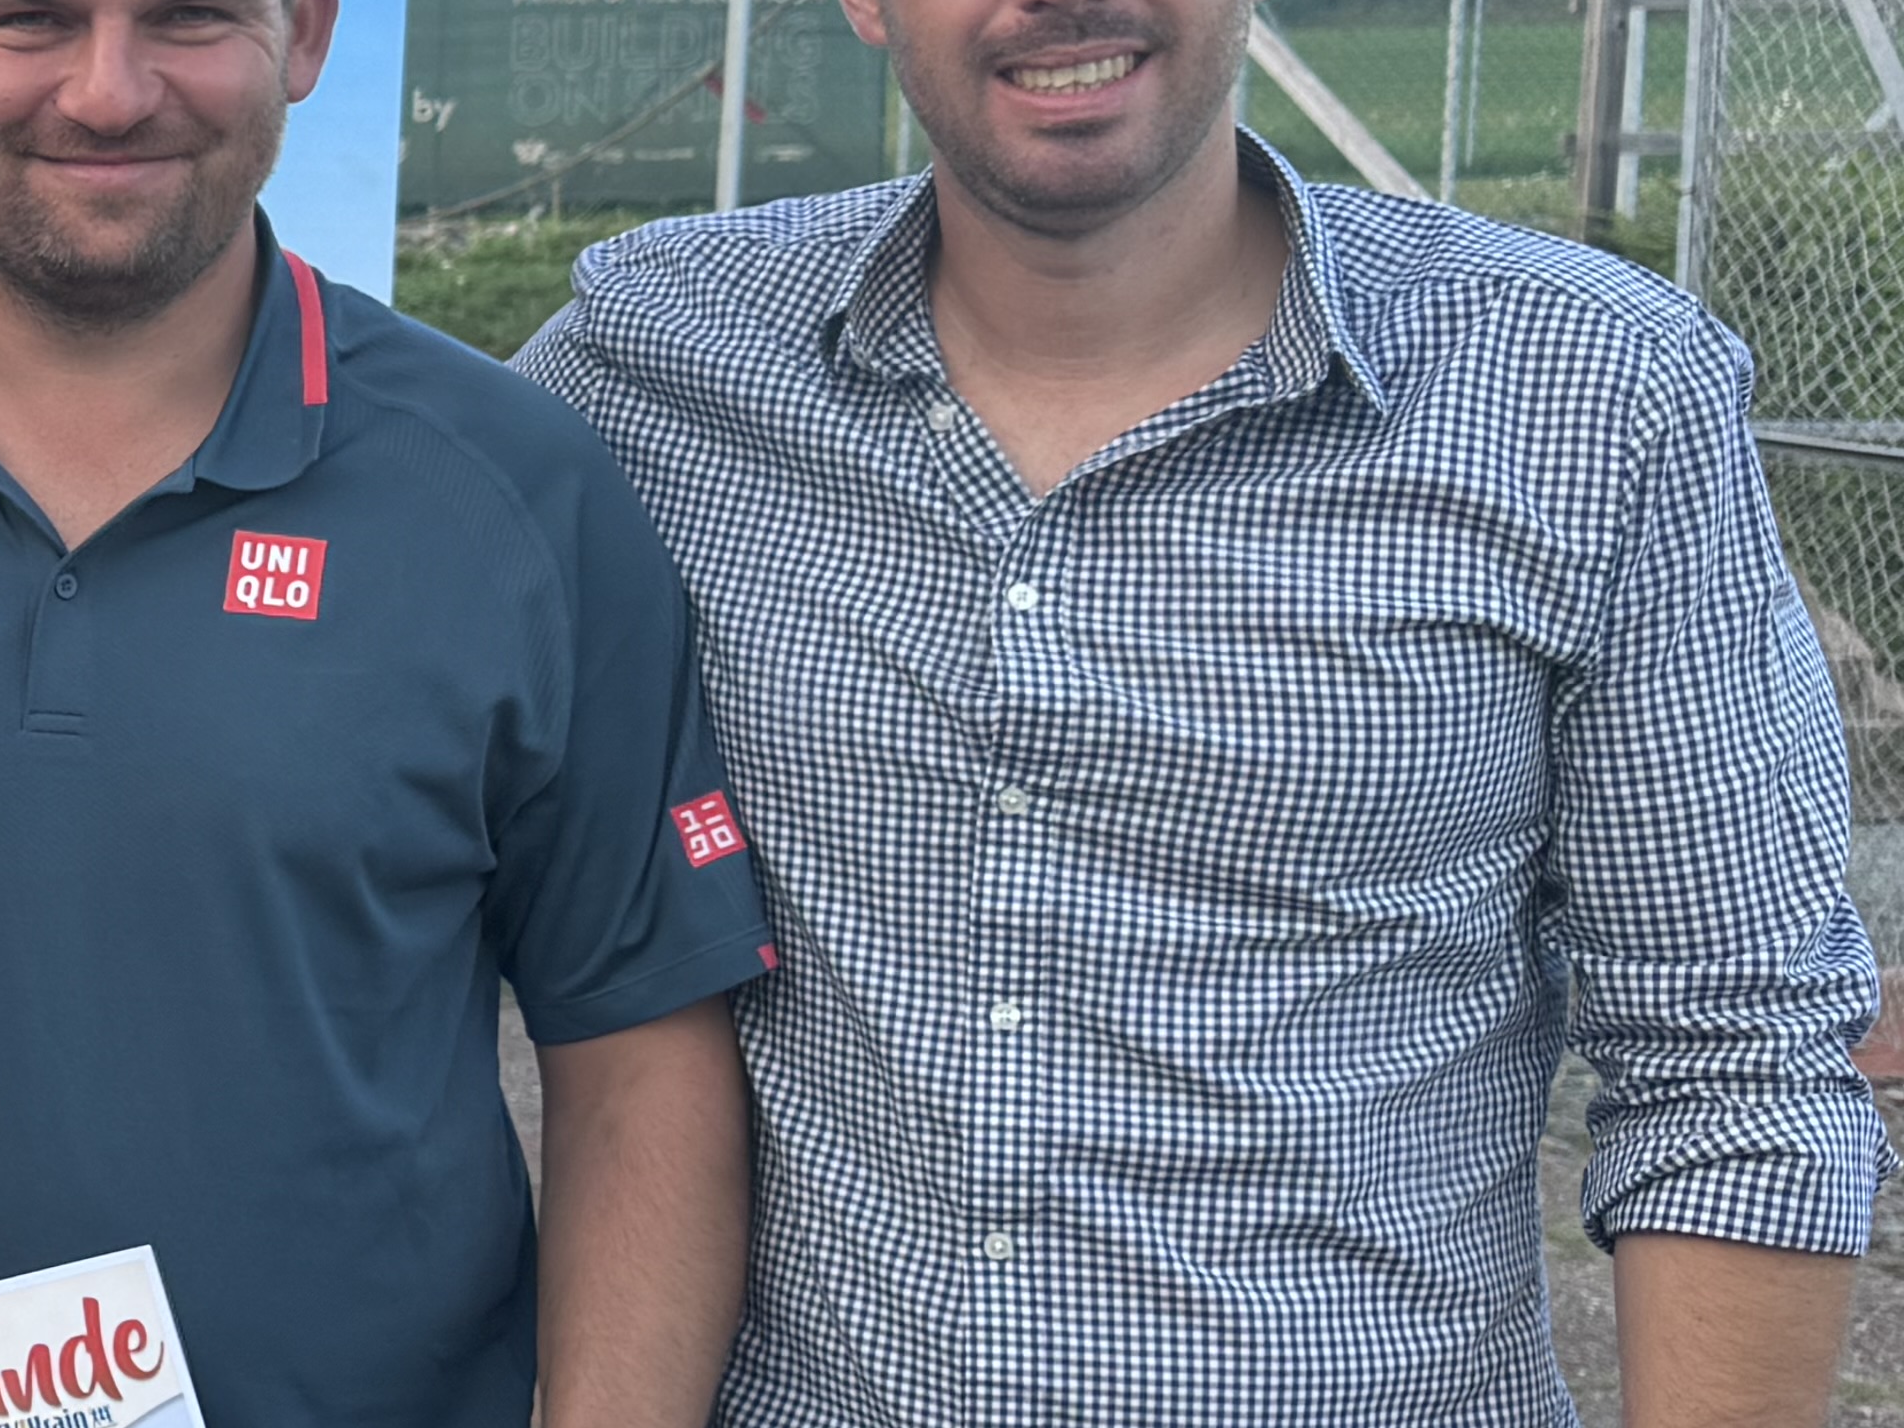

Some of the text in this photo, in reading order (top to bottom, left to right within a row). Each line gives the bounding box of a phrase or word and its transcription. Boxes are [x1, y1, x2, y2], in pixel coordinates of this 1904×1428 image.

[510, 10, 822, 72] BUILDIG
[413, 87, 458, 132] by
[240, 541, 308, 575] UNI
[236, 575, 310, 609] QLO
